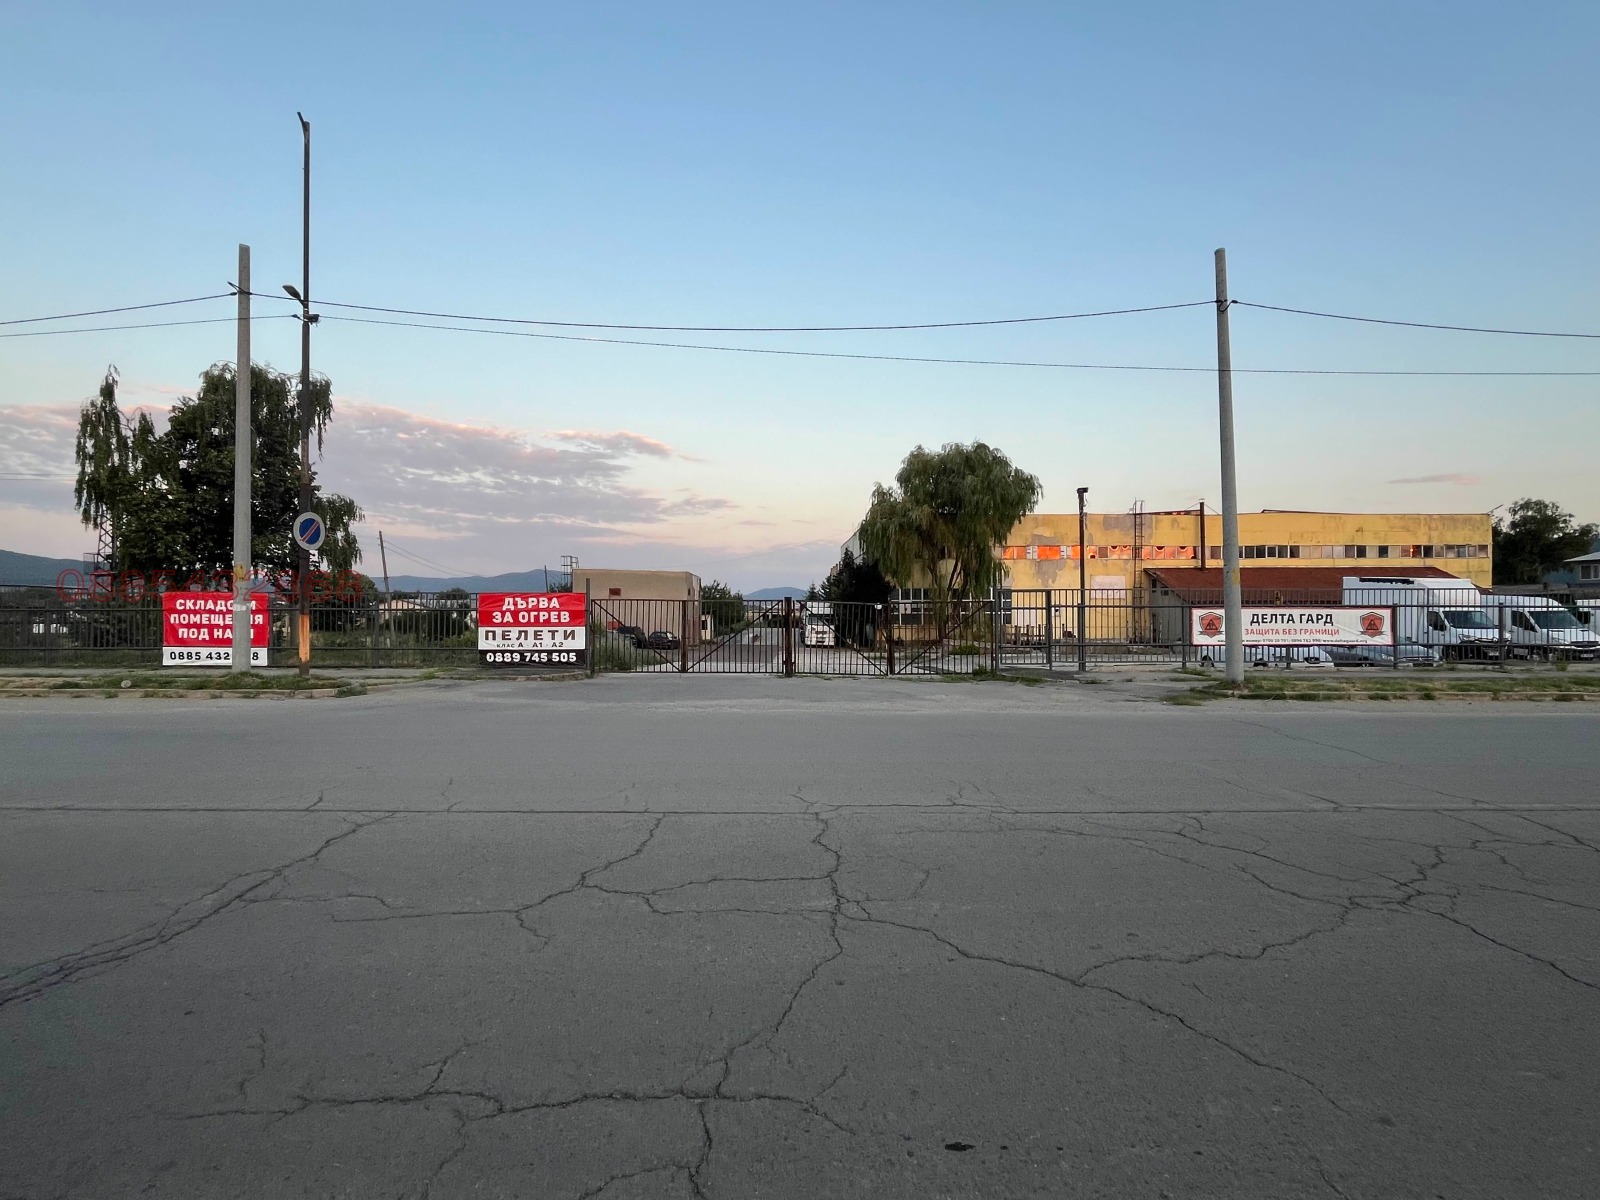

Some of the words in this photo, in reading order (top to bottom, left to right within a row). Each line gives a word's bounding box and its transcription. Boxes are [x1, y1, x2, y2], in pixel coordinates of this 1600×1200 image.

[502, 597, 560, 611] ДЪРВА
[492, 611, 514, 623] ЗА
[518, 611, 570, 623] ОГРЕВ
[1250, 613, 1295, 626] ДЕЛТА
[1299, 613, 1334, 626] ГАРД
[178, 628, 210, 640] ПОД
[484, 629, 576, 641] ПЕЛЕТИ
[1244, 628, 1280, 637] ЗАЩИТА
[1282, 628, 1297, 636] БЕЗ
[1299, 628, 1340, 637] ГРАНИЦИ
[170, 651, 201, 661] 0885
[205, 651, 231, 661] 432
[486, 652, 521, 662] 0889
[523, 652, 548, 662] 745
[551, 652, 577, 662] 505
